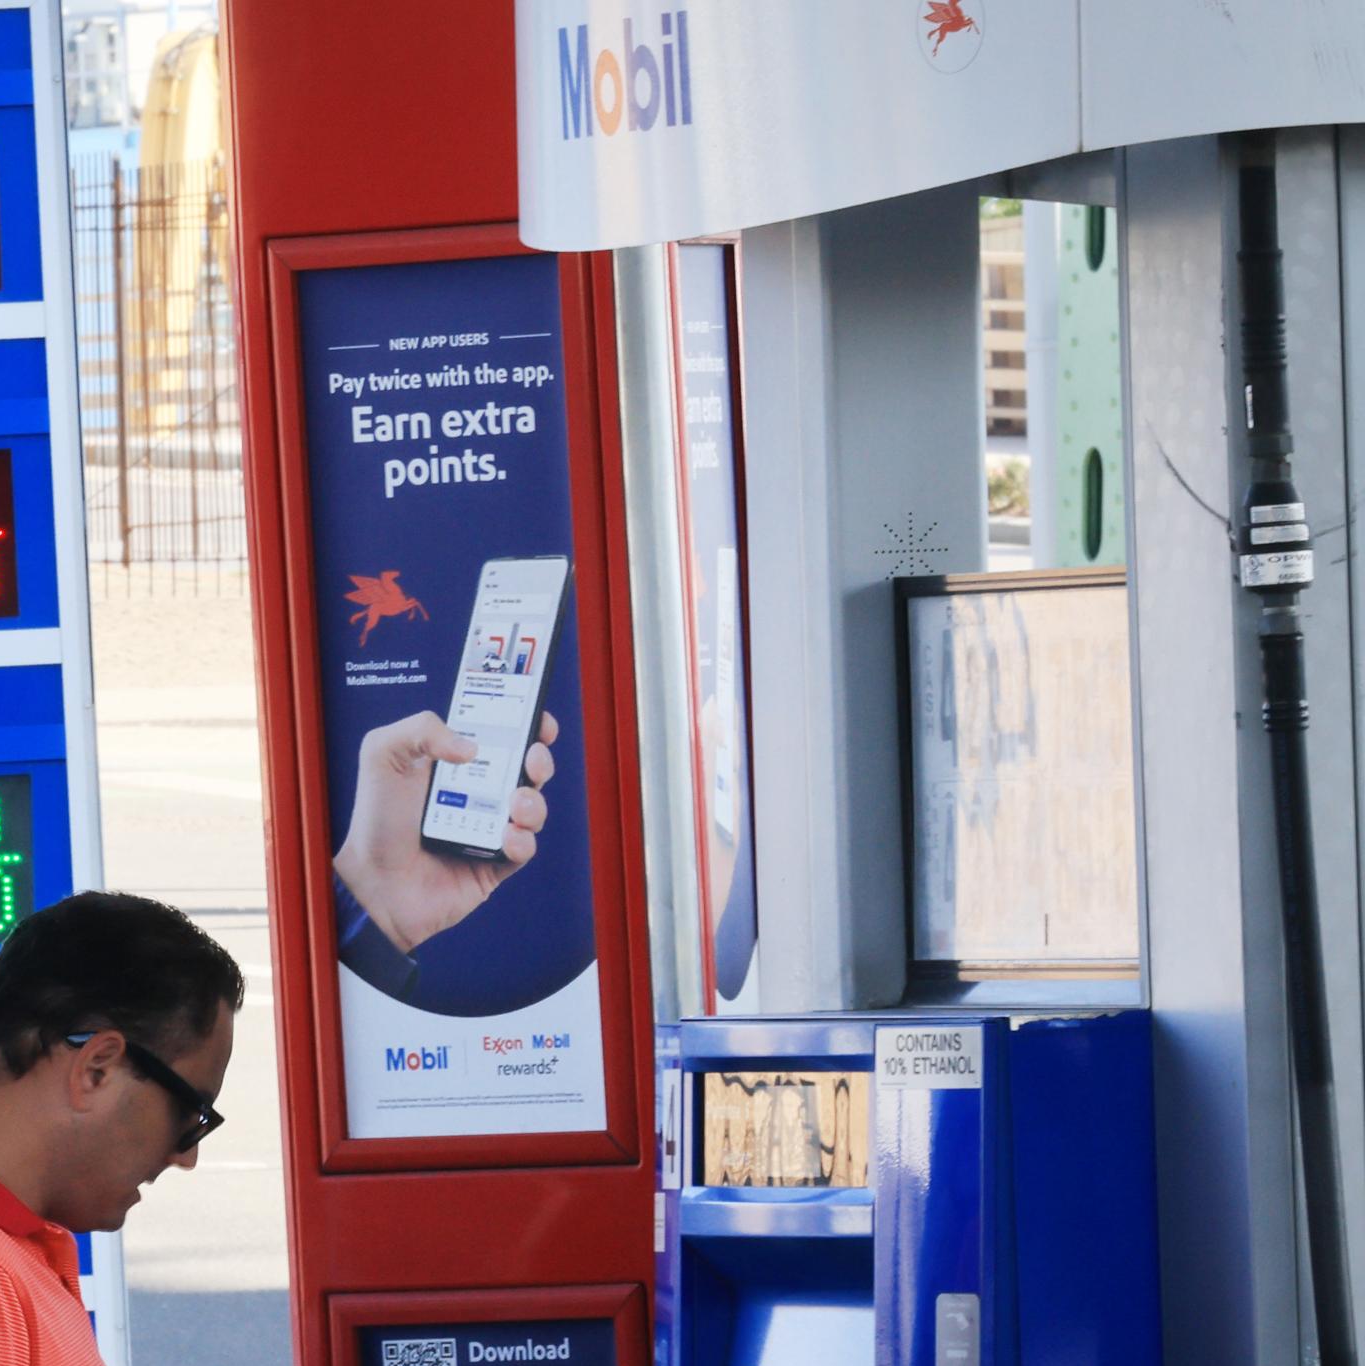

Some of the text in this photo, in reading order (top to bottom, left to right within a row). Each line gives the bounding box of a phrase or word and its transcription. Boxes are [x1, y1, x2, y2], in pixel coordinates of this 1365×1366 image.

[558, 10, 692, 141] Mobil
[388, 332, 490, 352] NEW APP USERS
[328, 364, 555, 400] Pay twice with the app.
[351, 402, 536, 444] Earn extra
[384, 446, 507, 498] points.
[345, 660, 389, 671] Download
[390, 661, 409, 669] now
[346, 673, 427, 686] MobilRewards.com
[386, 1033, 570, 1072] Mobil Exxon Mobil
[895, 1032, 963, 1054] CONTAINS
[883, 1055, 976, 1077] 10% ETHANOL
[468, 1337, 570, 1362] Download
